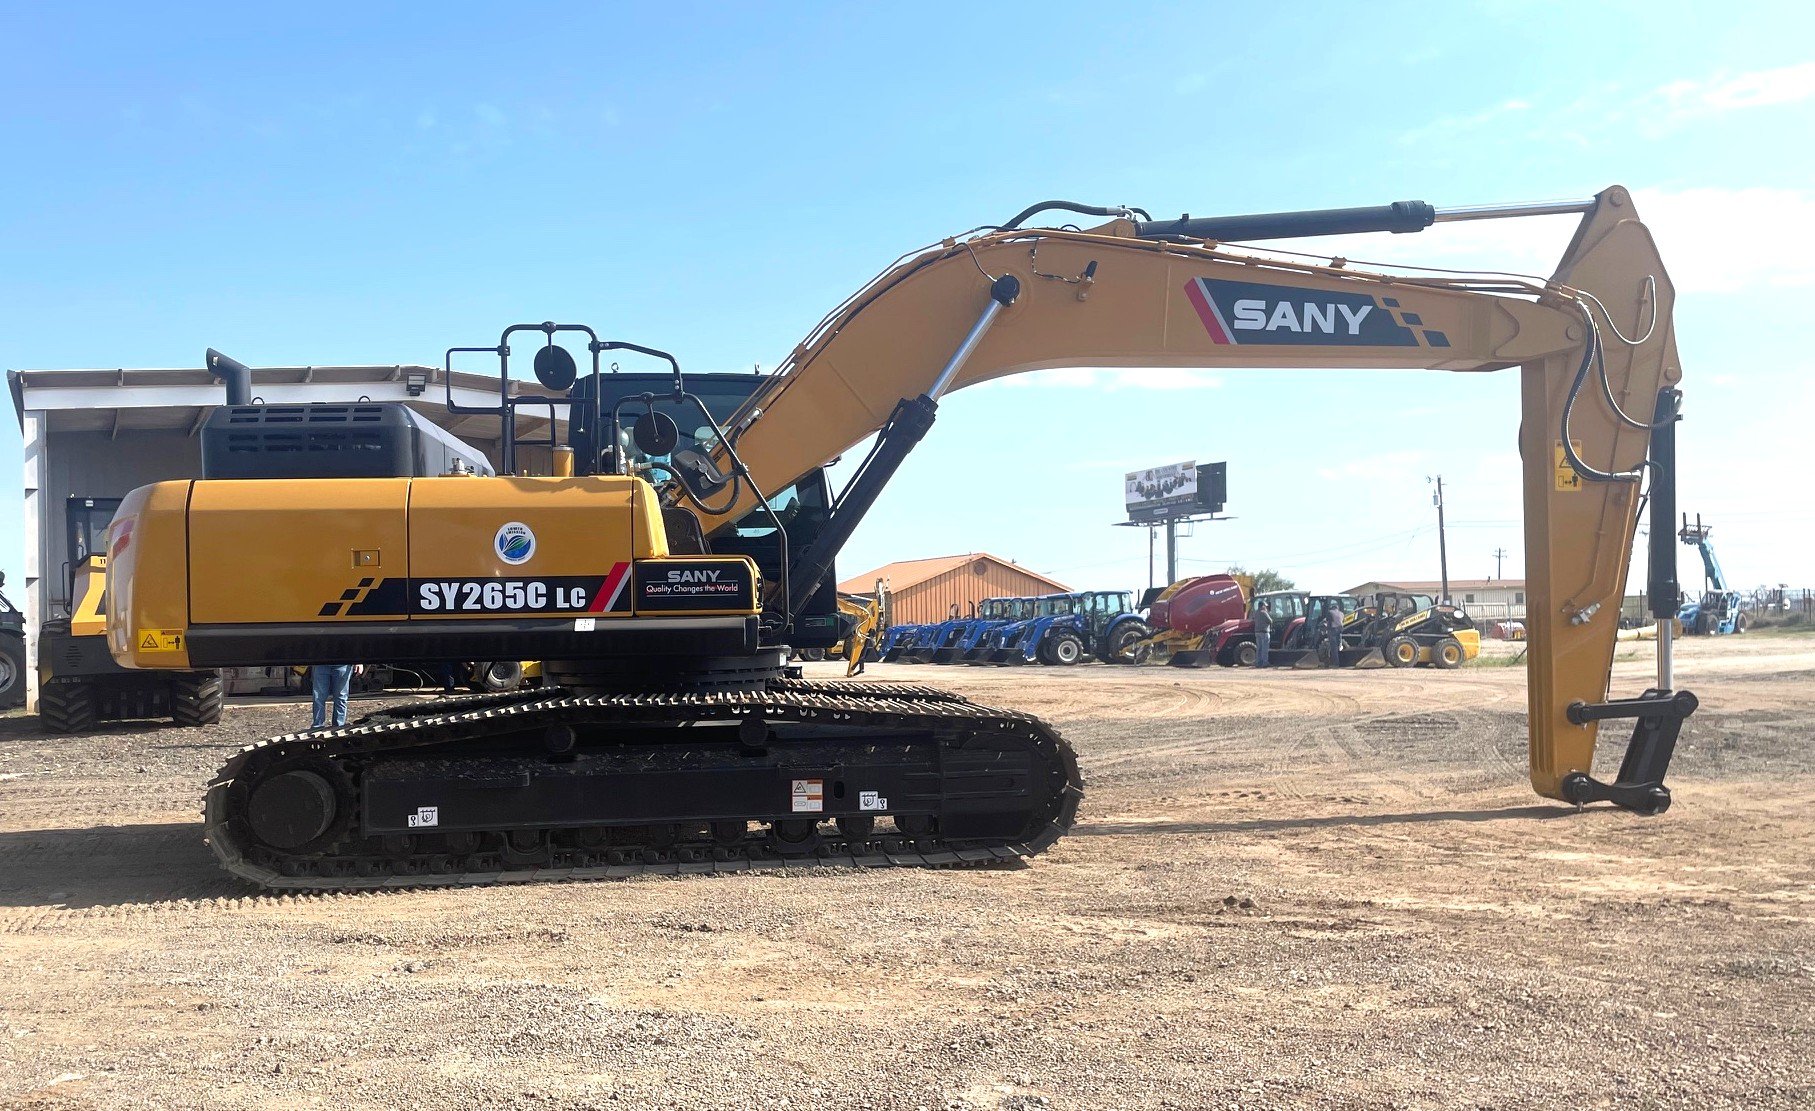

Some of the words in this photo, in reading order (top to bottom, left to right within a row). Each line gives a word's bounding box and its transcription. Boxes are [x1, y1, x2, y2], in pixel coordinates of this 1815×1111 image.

[1234, 299, 1374, 335] SANY
[667, 570, 721, 583] SANY
[419, 581, 547, 610] SY265C
[556, 587, 586, 608] LC
[646, 585, 672, 594] Quality
[673, 584, 703, 593] Changes
[704, 584, 715, 592] the
